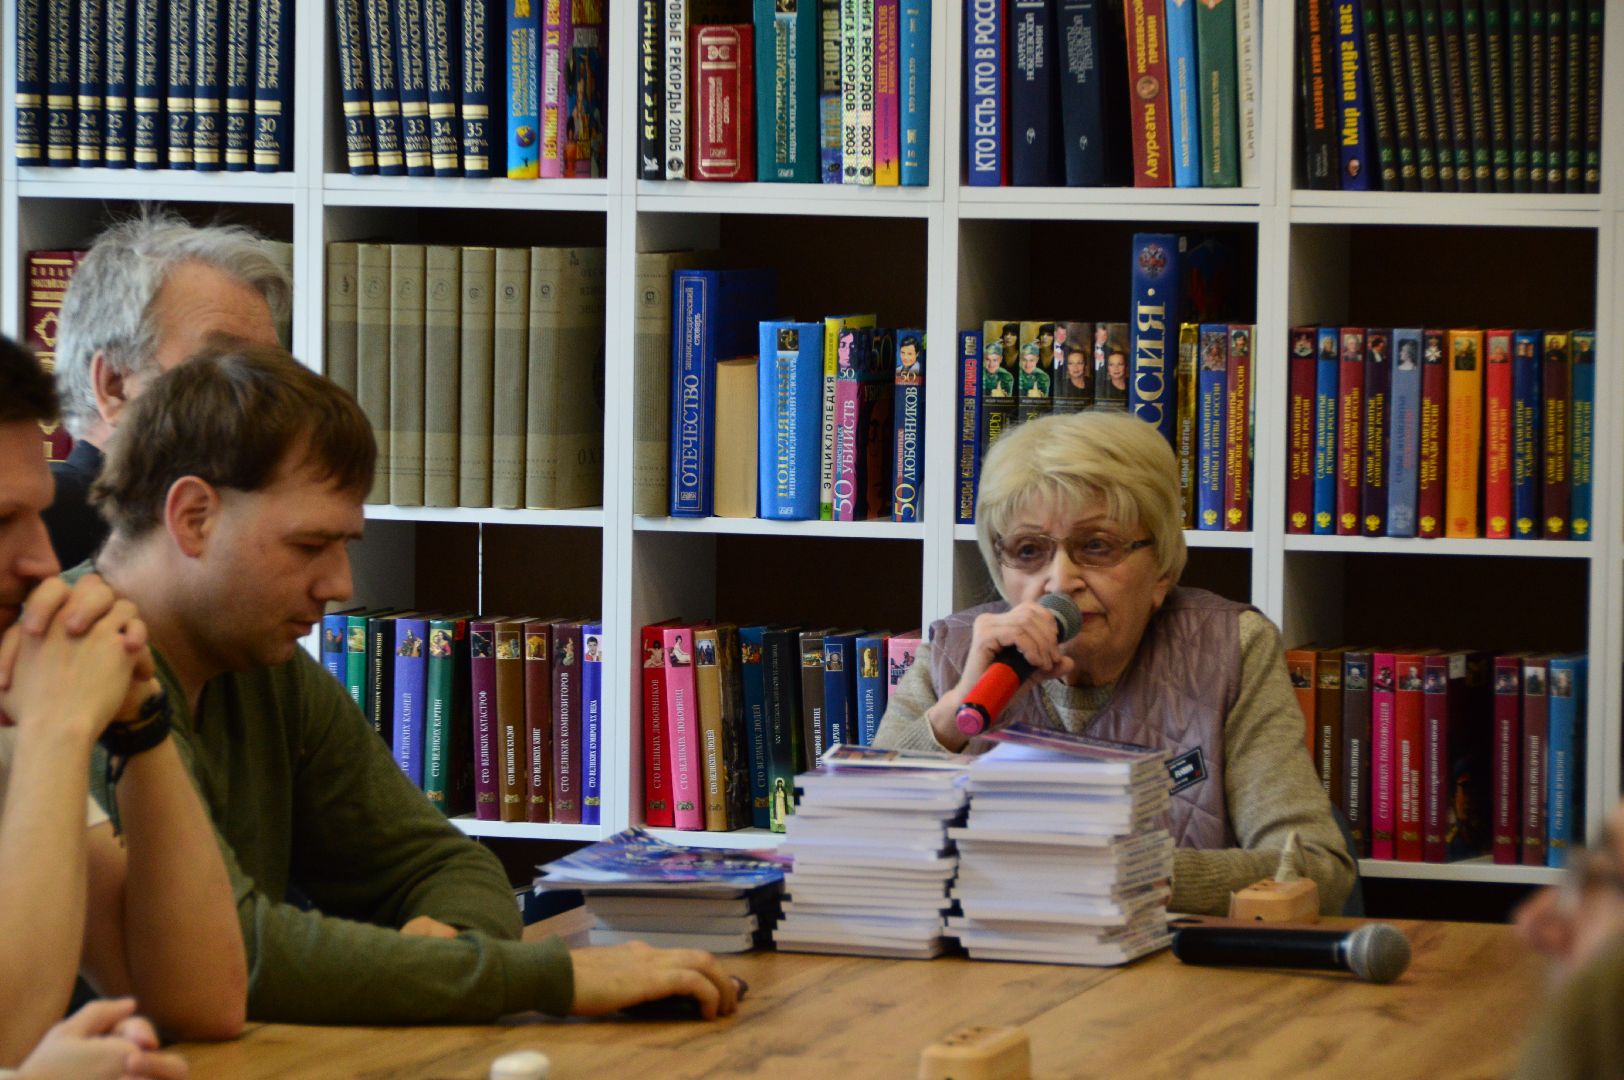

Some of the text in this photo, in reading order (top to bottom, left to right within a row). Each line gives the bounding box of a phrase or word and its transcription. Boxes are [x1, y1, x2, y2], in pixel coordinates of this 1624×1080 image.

[511, 28, 521, 63] КНИГА
[822, 9, 842, 91] РЕКОРДОВ
[878, 5, 888, 52] ФАКТОВ
[1017, 23, 1027, 70] ЛАУРЕАТЫ
[1026, 12, 1035, 80] НОБЕЛЕВСКОЙ
[1035, 26, 1044, 68] ПРЕМИИ
[1146, 15, 1159, 64] ПРЕМИИ
[511, 66, 523, 116] БОЛЬШАЯ
[544, 47, 561, 159] ВЕЛИКИЕ ЖЕНЩИНЫ
[643, 0, 658, 141] ВСЕ ТАЙНЫ
[668, 47, 684, 152] РЕКОРДЫ 2005
[774, 20, 787, 163] ИЛЛЮСТРИРОВАННЫЙ
[788, 16, 797, 163] ЭНЦИКЛОПЕДИЧЕСКИЙ СЛОВАРЬ
[843, 35, 857, 156] РЕКОРДОВ 2003
[860, 35, 873, 156] РЕКОРДОВ 2003
[878, 55, 889, 93] КНИГА
[974, 47, 996, 171] КТО ЕСТЬ КТО В
[1311, 34, 1325, 129] КРАСАВИЦЫ КУМИРЫ
[1339, 4, 1361, 146] Мир вокруг нас
[1367, 33, 1387, 138] ЭНЦИКЛОПЕДИЯ
[1407, 35, 1427, 139] ЭНЦИКЛОПЕДИЯ
[1488, 34, 1505, 141] ЭНЦИКЛОПЕДИЯ
[1550, 36, 1561, 141] ЭНЦИКЛОПЕДИЯ
[19, 111, 36, 125] 22
[50, 112, 68, 127] 23
[80, 112, 97, 127] 24
[108, 113, 122, 128] 25
[136, 115, 154, 129] 26
[171, 115, 189, 129] 27
[198, 116, 215, 130] 28
[228, 117, 245, 130] 29
[260, 117, 276, 131] 30
[349, 120, 364, 133] 31
[379, 119, 395, 133] 32
[408, 119, 425, 134] 33
[435, 121, 452, 135] 34
[467, 122, 483, 136] 35
[1144, 103, 1161, 178] Лауреаты
[681, 374, 699, 487] ОТЕЧЕСТВО
[776, 358, 791, 498] ПОПУЛЯРНЫЙ
[789, 358, 798, 499] ЭНЦИКЛОПЕДИЧЕСКИЙ СЛОВАРЬ
[823, 376, 836, 489] ЭНЦИКЛОПЕДИЯ
[840, 399, 855, 475] УБИЙСТВ
[903, 386, 918, 481] ЛЮБОВНИКОВ
[960, 335, 977, 519] 500 САМЫХ ВЕЛИКИХ ЛЮДЕЙ РОССИИ
[1202, 392, 1212, 484] САМЫЕ ЗНАМЕНИТЫЕ
[1211, 383, 1221, 491] ВОЙНЫ БИТВЫ РОССИИ
[1227, 391, 1238, 476] САМЫЕ ЗНАМЕНИТЫЕ
[1234, 366, 1245, 500] ГЕОРГИЕВСКИЕ КАВАЛЕРЫ РОССИИ
[1292, 394, 1302, 480] САМЫЕ ЗНАМЕНИТЫЕ
[1301, 399, 1311, 476] ДИНАСТИИ РОССИИ
[1317, 393, 1327, 480] САМЫЕ ЗНАМЕНИТЫЕ
[1326, 398, 1336, 474] ИСТОРИКИ РОССИИ
[1343, 394, 1352, 480] САМЫЕ ЗНАМЕНИТЫЕ
[1352, 387, 1360, 419] РОССИИ
[1367, 398, 1376, 483] САМЫЕ ЗНАМЕНИТЫЕ
[1374, 393, 1384, 486] КОМПОЗИТОРЫ РОССИИ
[1431, 405, 1440, 438] РОССИИ
[1500, 409, 1508, 441] РОССИИ
[1180, 459, 1190, 489] Самые
[1420, 397, 1430, 490] САМЫЕ ЗНАМЕНИТЫЕ
[834, 479, 853, 515] 50
[895, 483, 915, 518] 50
[401, 692, 412, 759] ВЕЛИКИХ КАЗНЕЙ
[432, 699, 443, 777] СТО ВЕЛИКИХ КАРТИН
[479, 690, 490, 784] СТО ВЕЛИКИХ КАТАСТРОФ
[560, 672, 569, 792] СТО ВЕЛИКИХ КОМПОЗИТОРОВ
[588, 699, 598, 788] СТО ВЕЛИКИХ КУМИРОВ ВЕКА
[651, 679, 662, 789] СТО ВЕЛИКИХ ЛЮБОВНИКОВ
[675, 688, 689, 790] СТО ВЕЛИКИХ ЛЮБОВНИЦ
[752, 704, 767, 788] СТО ВЕЛИКИХ ЛЮДЕЙ
[813, 707, 822, 728] ЛЕГЕНД
[813, 735, 822, 756] МИФОВ
[865, 688, 875, 745] МУЗЕЕВ МИРА
[506, 725, 516, 786] СТО ВЕЛИКИХ КЛАДОВ
[532, 727, 542, 787] СТО ВЕЛИКИХ КНИГ
[706, 729, 718, 794] СТО ВЕЛИКИХ ЛЮДЕЙ
[1349, 738, 1359, 821] СТО ВЕЛИКИХ ПОЛИТИКОВ
[1379, 702, 1390, 819] СТО ВЕЛИКИХ ПОЛКОВОДЦЕВ
[1401, 740, 1410, 810] ВЕЛИКИХ ПОЛКОВОДЦЕВ
